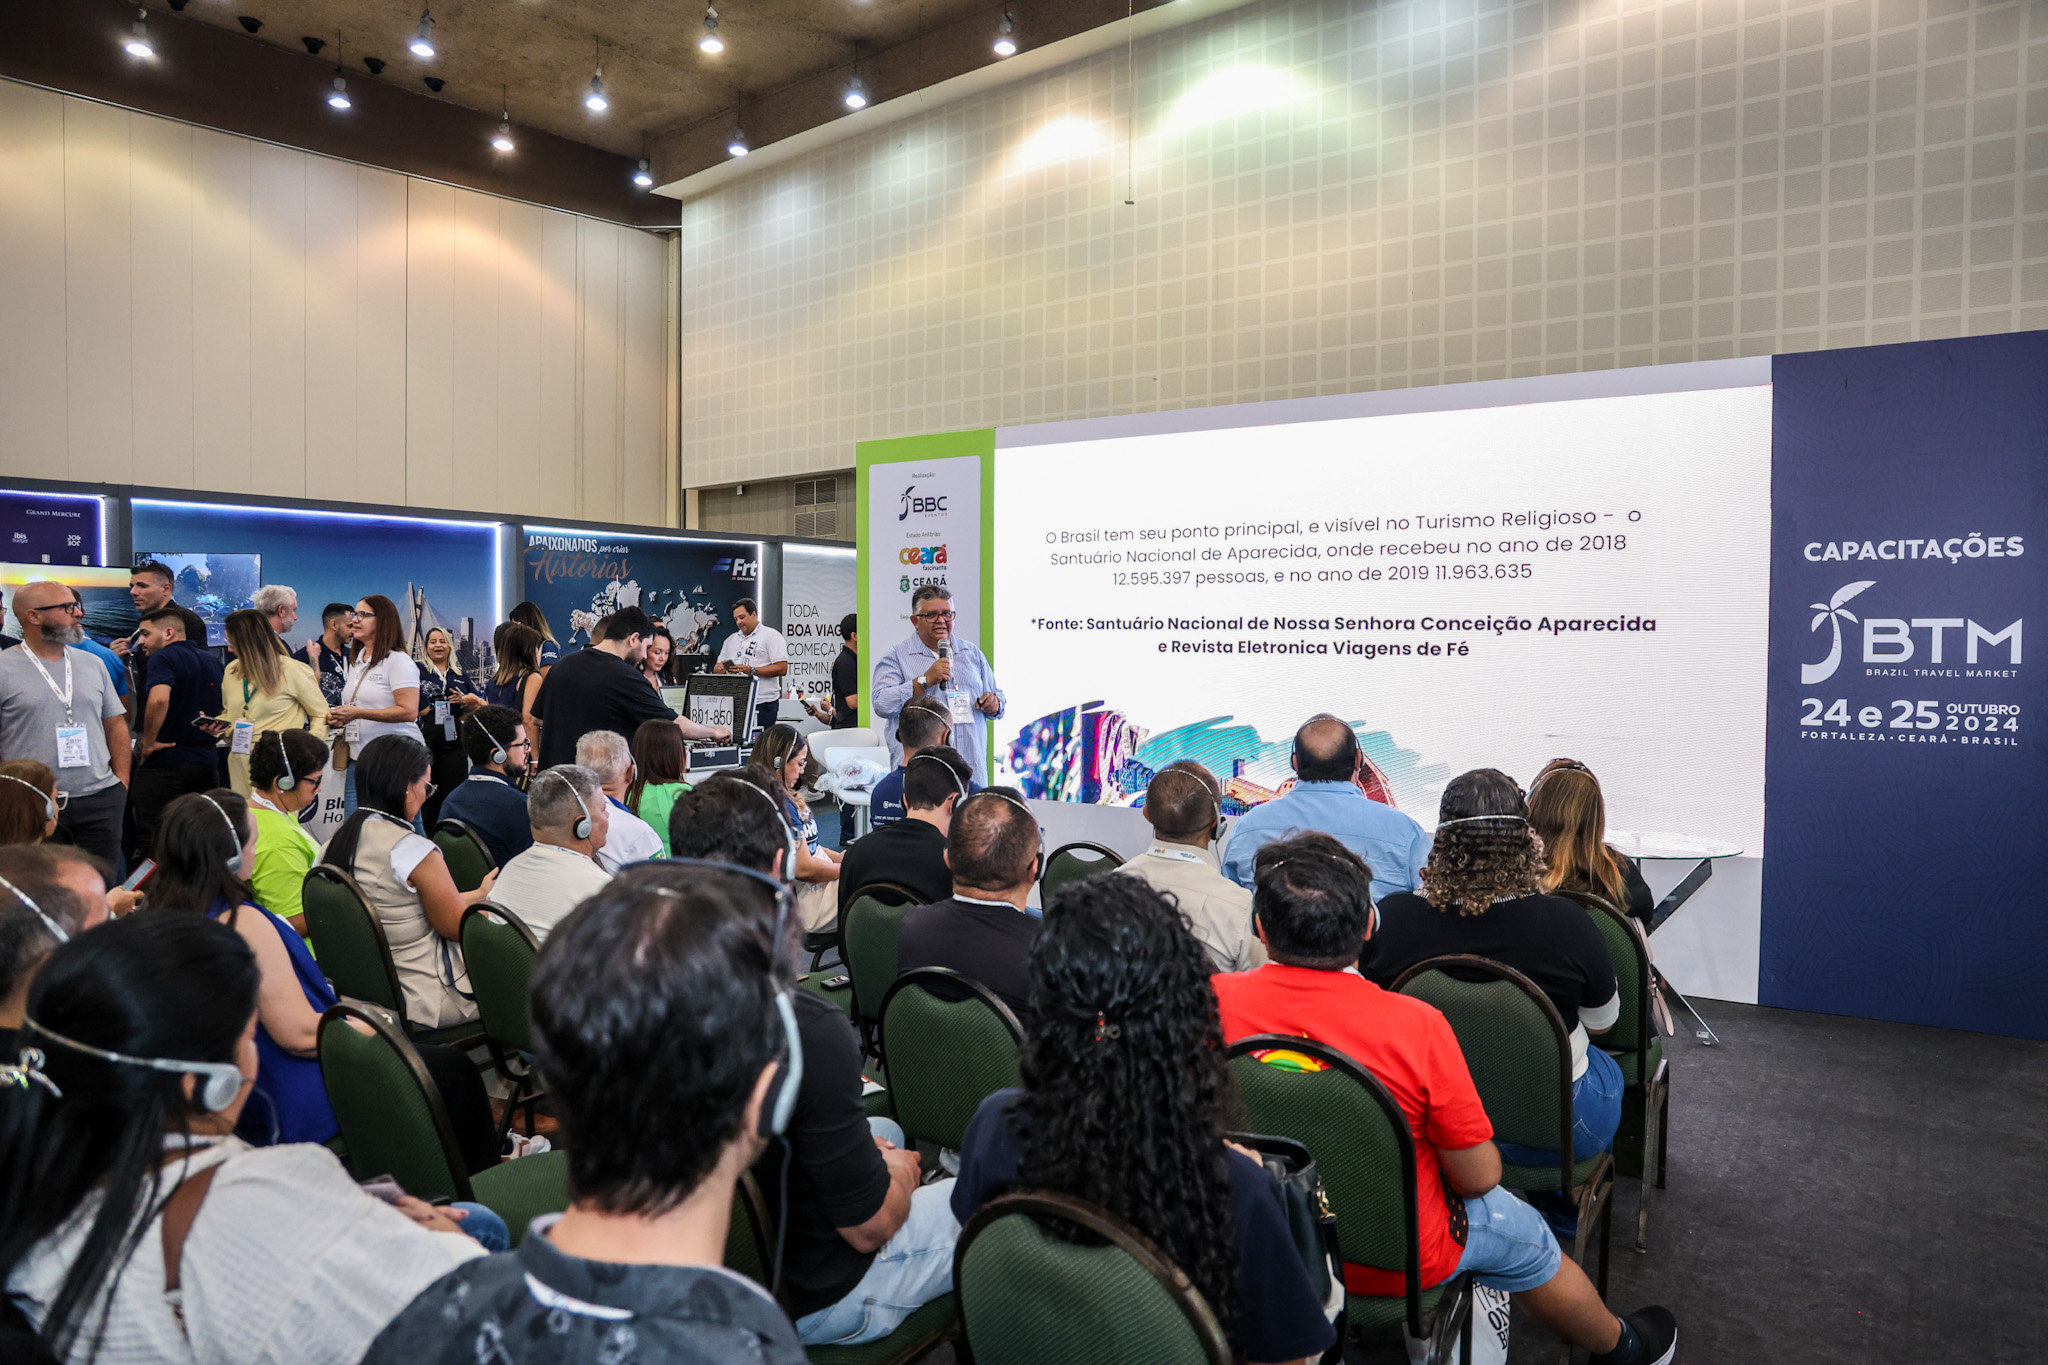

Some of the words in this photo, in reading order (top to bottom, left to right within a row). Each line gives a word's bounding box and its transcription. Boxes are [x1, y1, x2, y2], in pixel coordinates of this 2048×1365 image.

[913, 496, 947, 513] BBC
[1046, 532, 1057, 544] O
[1061, 529, 1100, 543] Brasil
[1104, 529, 1134, 541] tem
[1139, 528, 1167, 540] seu
[1171, 525, 1220, 543] ponto
[1224, 520, 1303, 541] principal,
[1308, 522, 1320, 534] e
[1325, 516, 1380, 533] visível
[1386, 519, 1410, 531] no
[1415, 513, 1495, 530] Turismo
[1502, 509, 1597, 531] Religioso
[528, 535, 598, 553] APAIXONADOS
[598, 545, 611, 555] por
[899, 543, 948, 565] ceará
[1050, 552, 1122, 566] Santuário
[1126, 548, 1196, 563] Nacional
[1201, 547, 1222, 561] de
[1226, 545, 1321, 564] Aparecida,
[1326, 541, 1374, 557] onde
[1379, 539, 1461, 556] recebeu
[1466, 541, 1492, 554] no
[1498, 540, 1539, 553] ano
[1545, 535, 1573, 552] de
[1579, 534, 1627, 551] 2018
[1803, 532, 2025, 565] CAPACITAÇÕES
[523, 545, 633, 585] Histórias
[731, 558, 758, 578] Frt
[912, 574, 948, 587] CEARÁ
[1113, 571, 1191, 586] 12.595.397
[1195, 571, 1269, 588] pessoas,
[1273, 571, 1285, 583] e
[1289, 570, 1312, 582] no
[1317, 569, 1353, 582] ano
[1357, 566, 1383, 581] de
[1388, 565, 1429, 581] 2019
[1435, 563, 1533, 580] 11.963.635
[787, 604, 819, 618] TODA
[787, 624, 812, 637] BOA
[816, 624, 842, 637] VIAG
[1086, 615, 1165, 631] Santuário
[1167, 615, 1244, 631] Nacional
[1247, 616, 1270, 631] de
[1273, 616, 1330, 631] Nossa
[1334, 615, 1416, 632] Senhora
[1420, 614, 1533, 637] Conceição
[1537, 614, 1657, 637] Aparecida
[787, 642, 837, 657] COMEÇA
[1157, 642, 1168, 653] e
[1171, 638, 1234, 654] Revista
[1237, 639, 1328, 655] Eletronica
[1332, 639, 1412, 661] Viagens
[1416, 640, 1442, 657] de
[1446, 638, 1470, 658] Fé
[1862, 617, 2023, 665] BTM
[1866, 668, 1909, 677] BRAZIL
[1913, 669, 1961, 677] TRAVEL
[1965, 669, 2018, 678] MARKET
[808, 680, 832, 694] SOR
[691, 708, 733, 726] 801-850
[1800, 697, 1852, 727] 24
[1858, 705, 1883, 728] e
[1889, 699, 1941, 730] 25
[1946, 703, 2021, 716] OUTUBRO
[1945, 715, 2019, 732] 2024
[1801, 731, 1886, 742] FORTALEZA
[1898, 734, 1948, 744] CEARÁ
[1961, 736, 2018, 746] BRASIL
[323, 812, 343, 824] Ho
